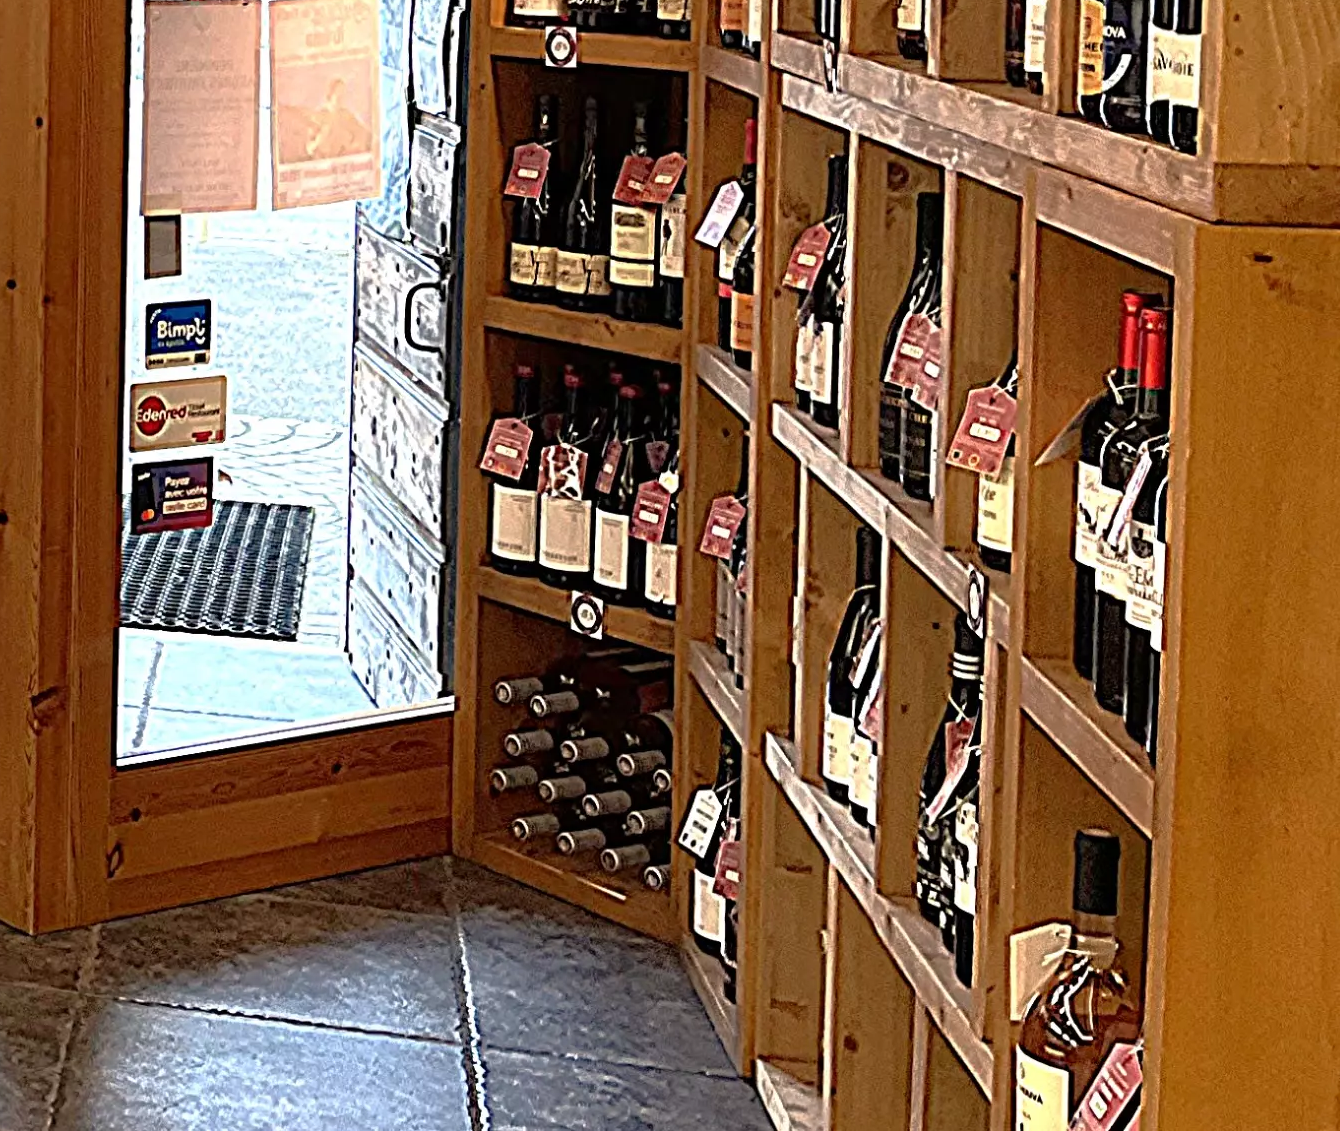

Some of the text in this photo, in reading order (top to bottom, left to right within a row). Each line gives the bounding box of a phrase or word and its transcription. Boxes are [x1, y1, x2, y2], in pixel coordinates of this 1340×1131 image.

[157, 317, 206, 343] Bimpli
[135, 405, 187, 423] Edenred
[165, 489, 185, 498] avec
